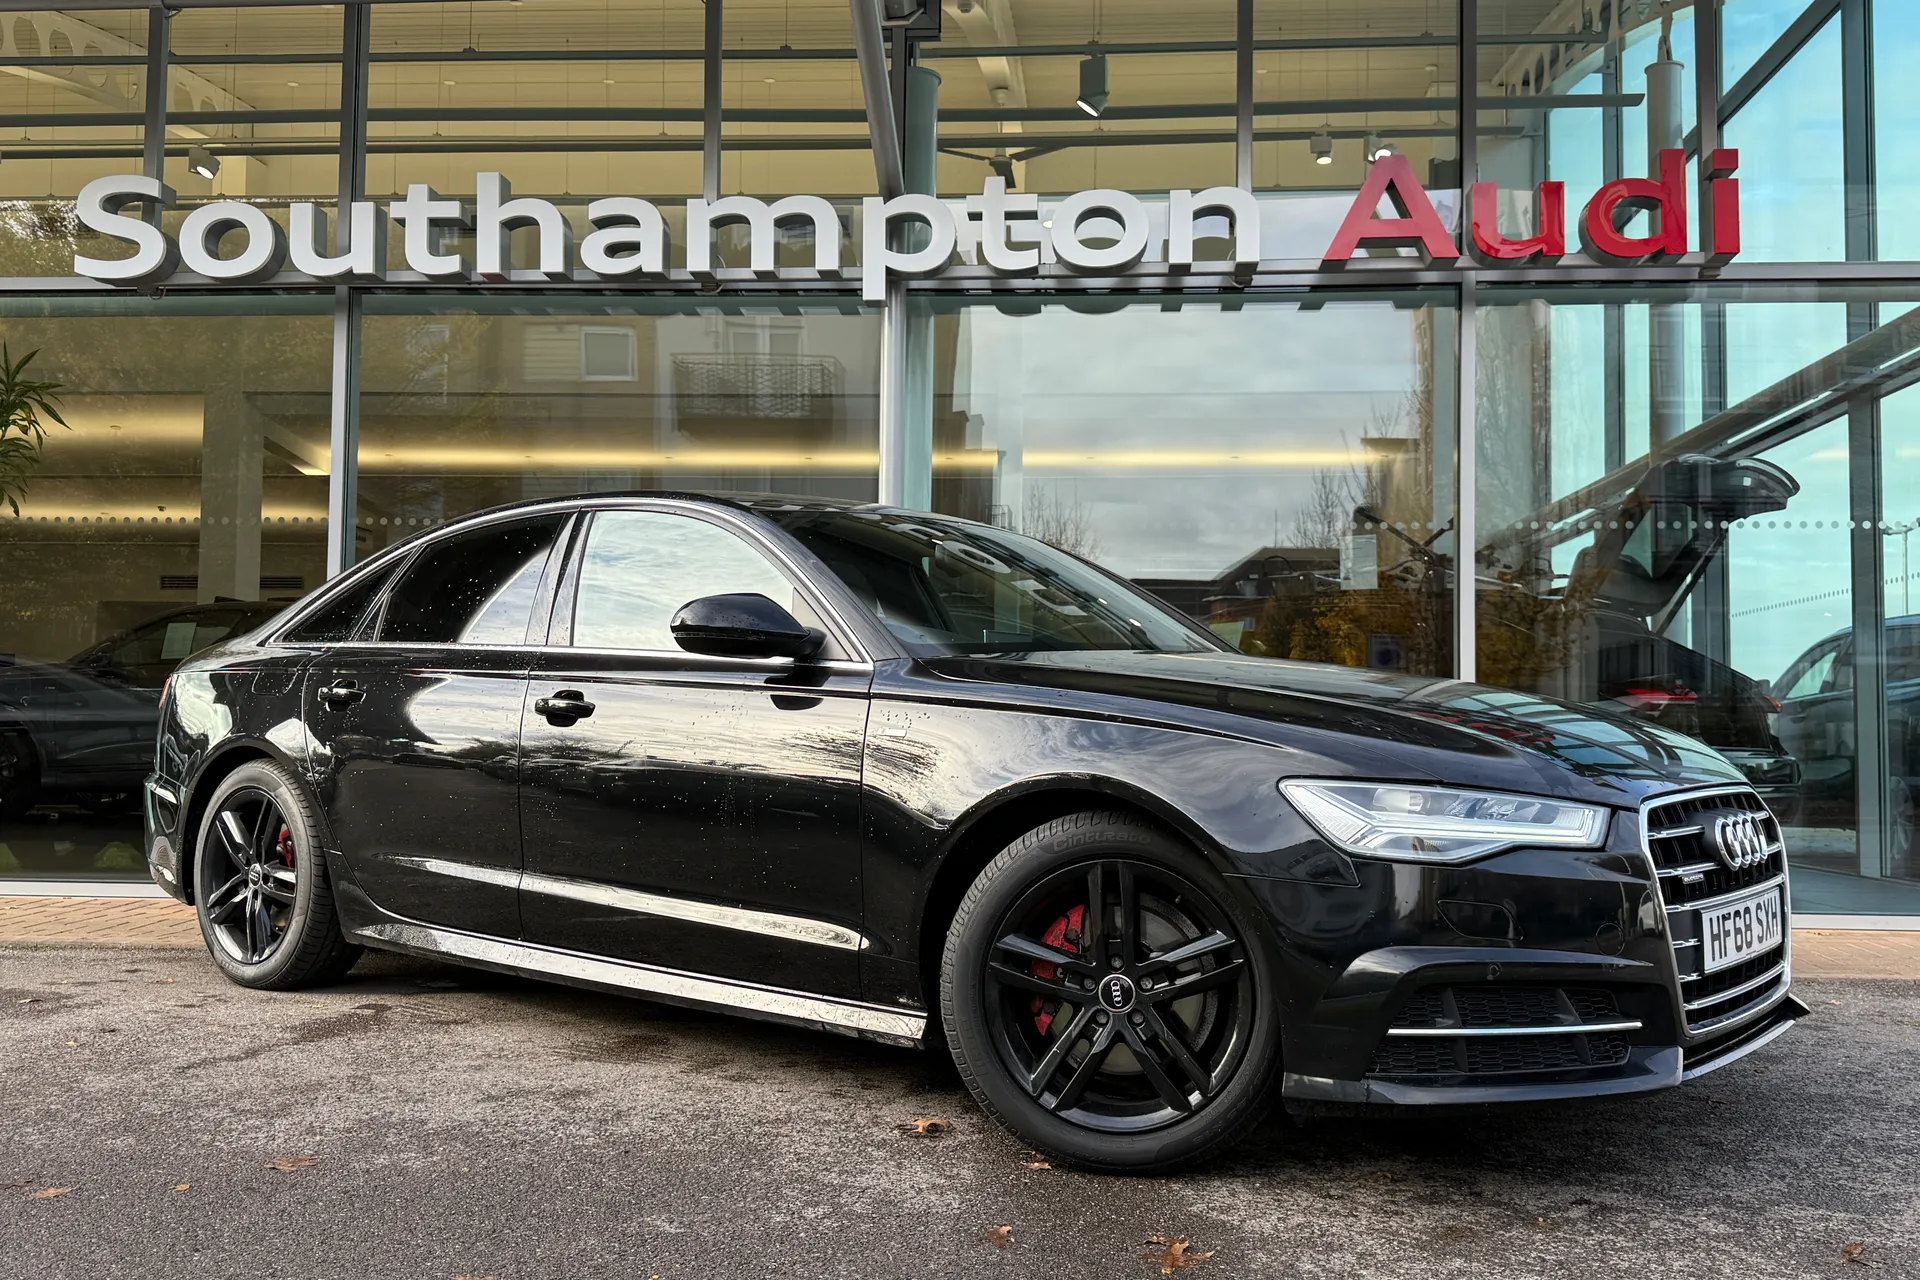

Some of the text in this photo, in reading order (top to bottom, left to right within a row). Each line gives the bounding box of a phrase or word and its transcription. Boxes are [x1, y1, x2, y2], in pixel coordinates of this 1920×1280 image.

[74, 148, 1740, 303] Southampton Audi
[1709, 896, 1778, 961] HF68 SXH
